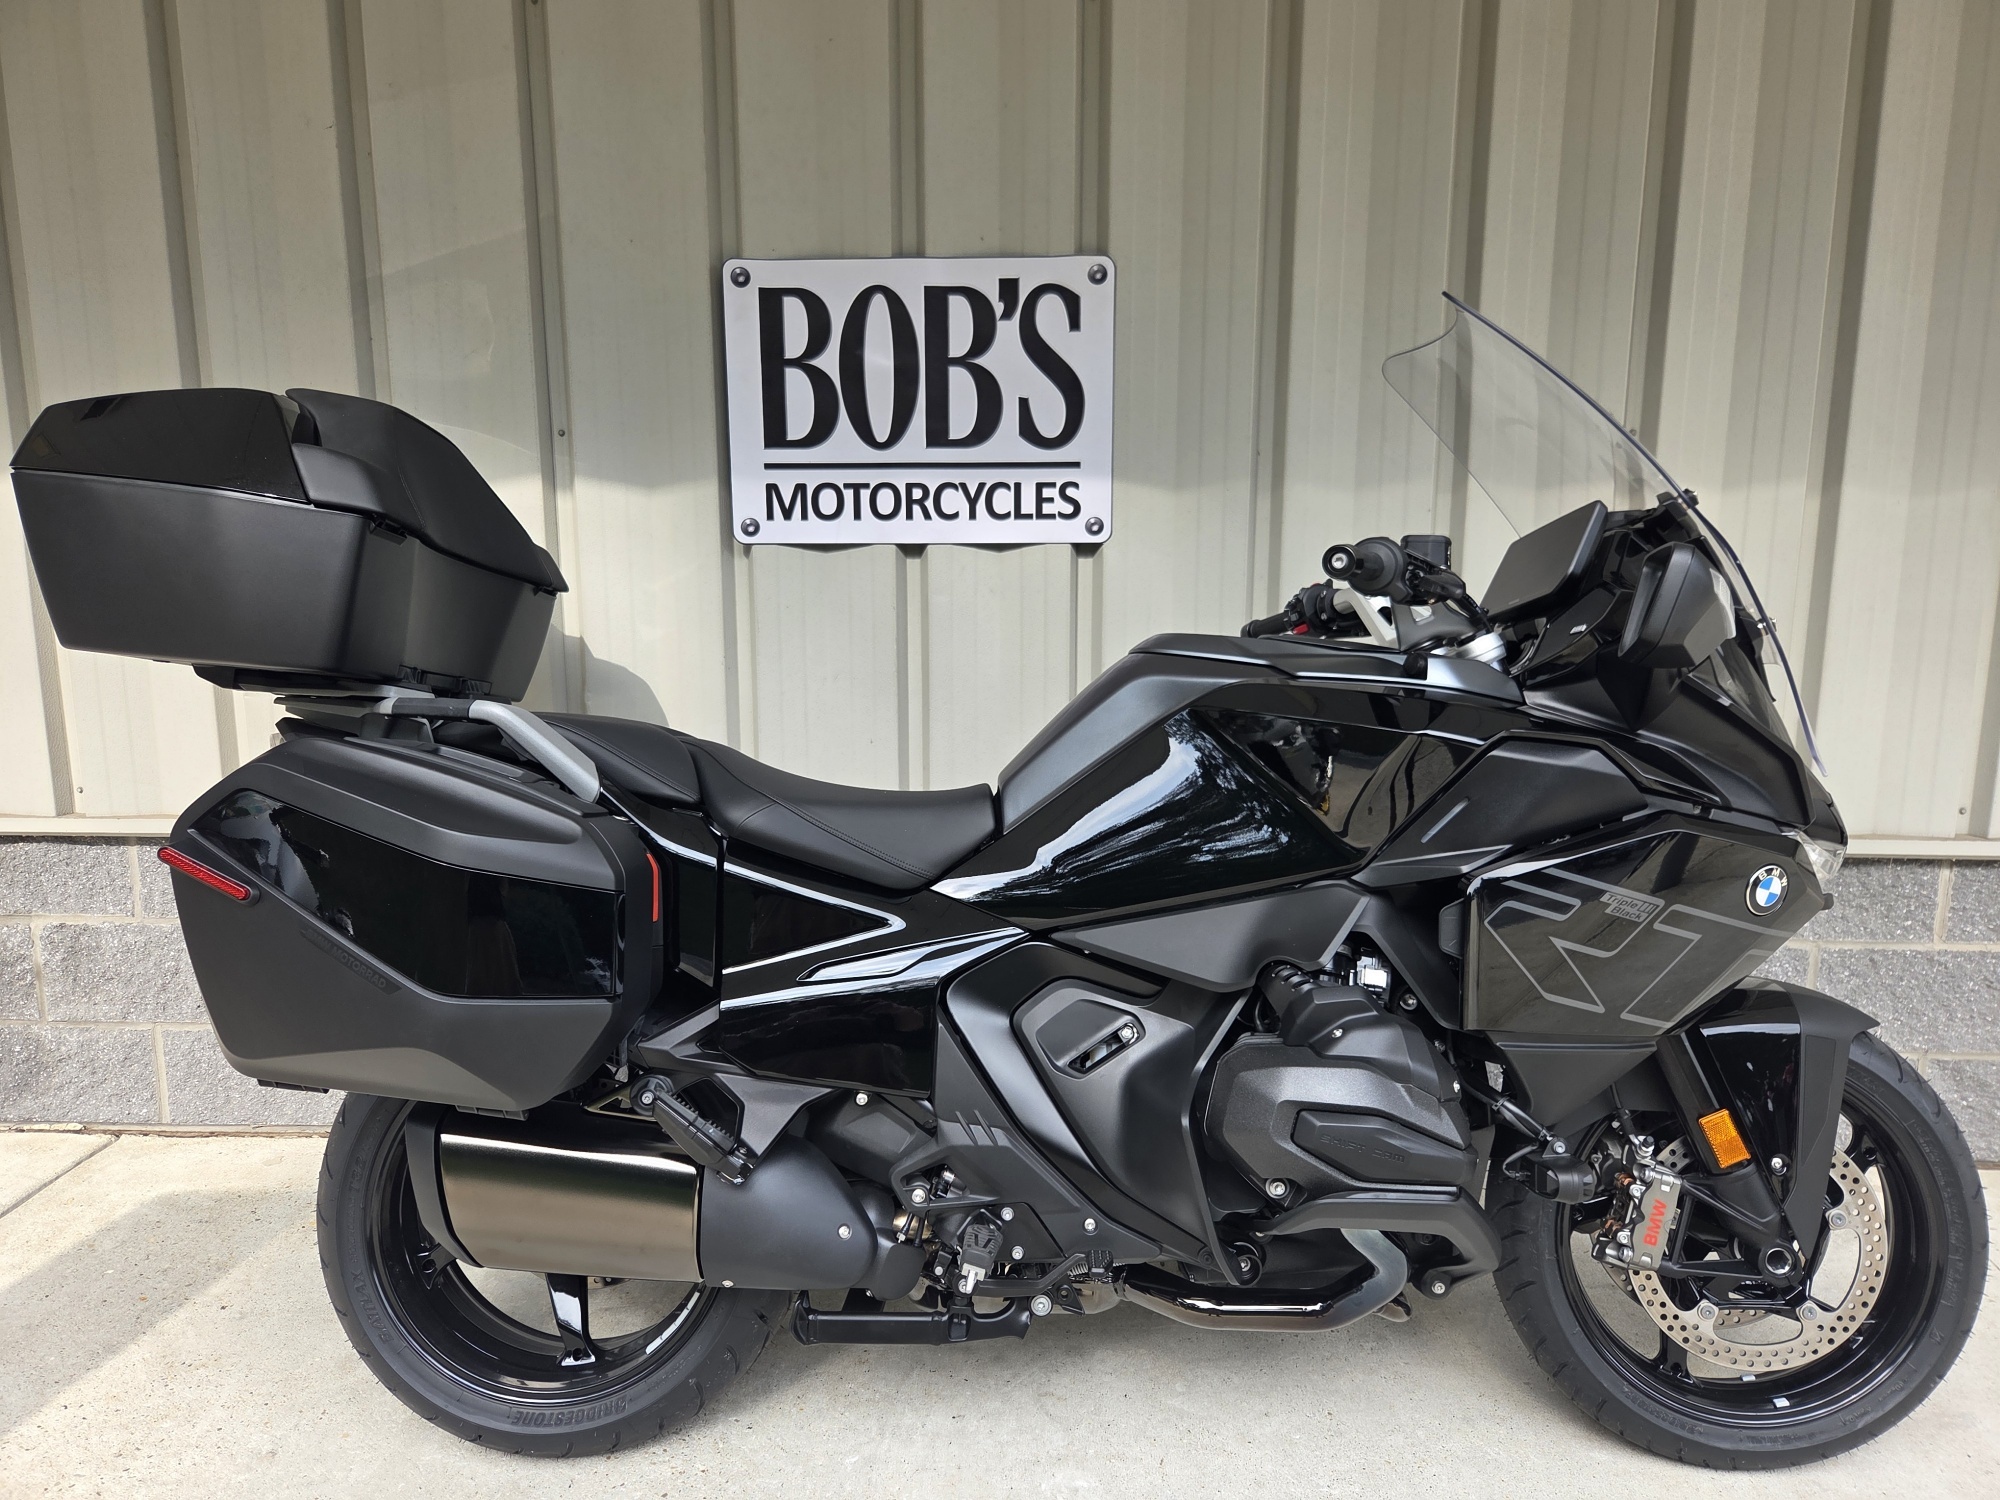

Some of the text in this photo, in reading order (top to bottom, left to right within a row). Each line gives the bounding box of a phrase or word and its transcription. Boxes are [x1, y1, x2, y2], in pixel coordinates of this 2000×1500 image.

[758, 277, 1085, 451] BOB'S
[764, 481, 1082, 522] MOTORCYCLES
[1606, 893, 1638, 909] Triple
[1610, 906, 1642, 920] Black
[331, 945, 387, 989] MOTORRAD
[1643, 1198, 1668, 1247] BMW
[511, 1399, 628, 1428] BRIDGESTONE
